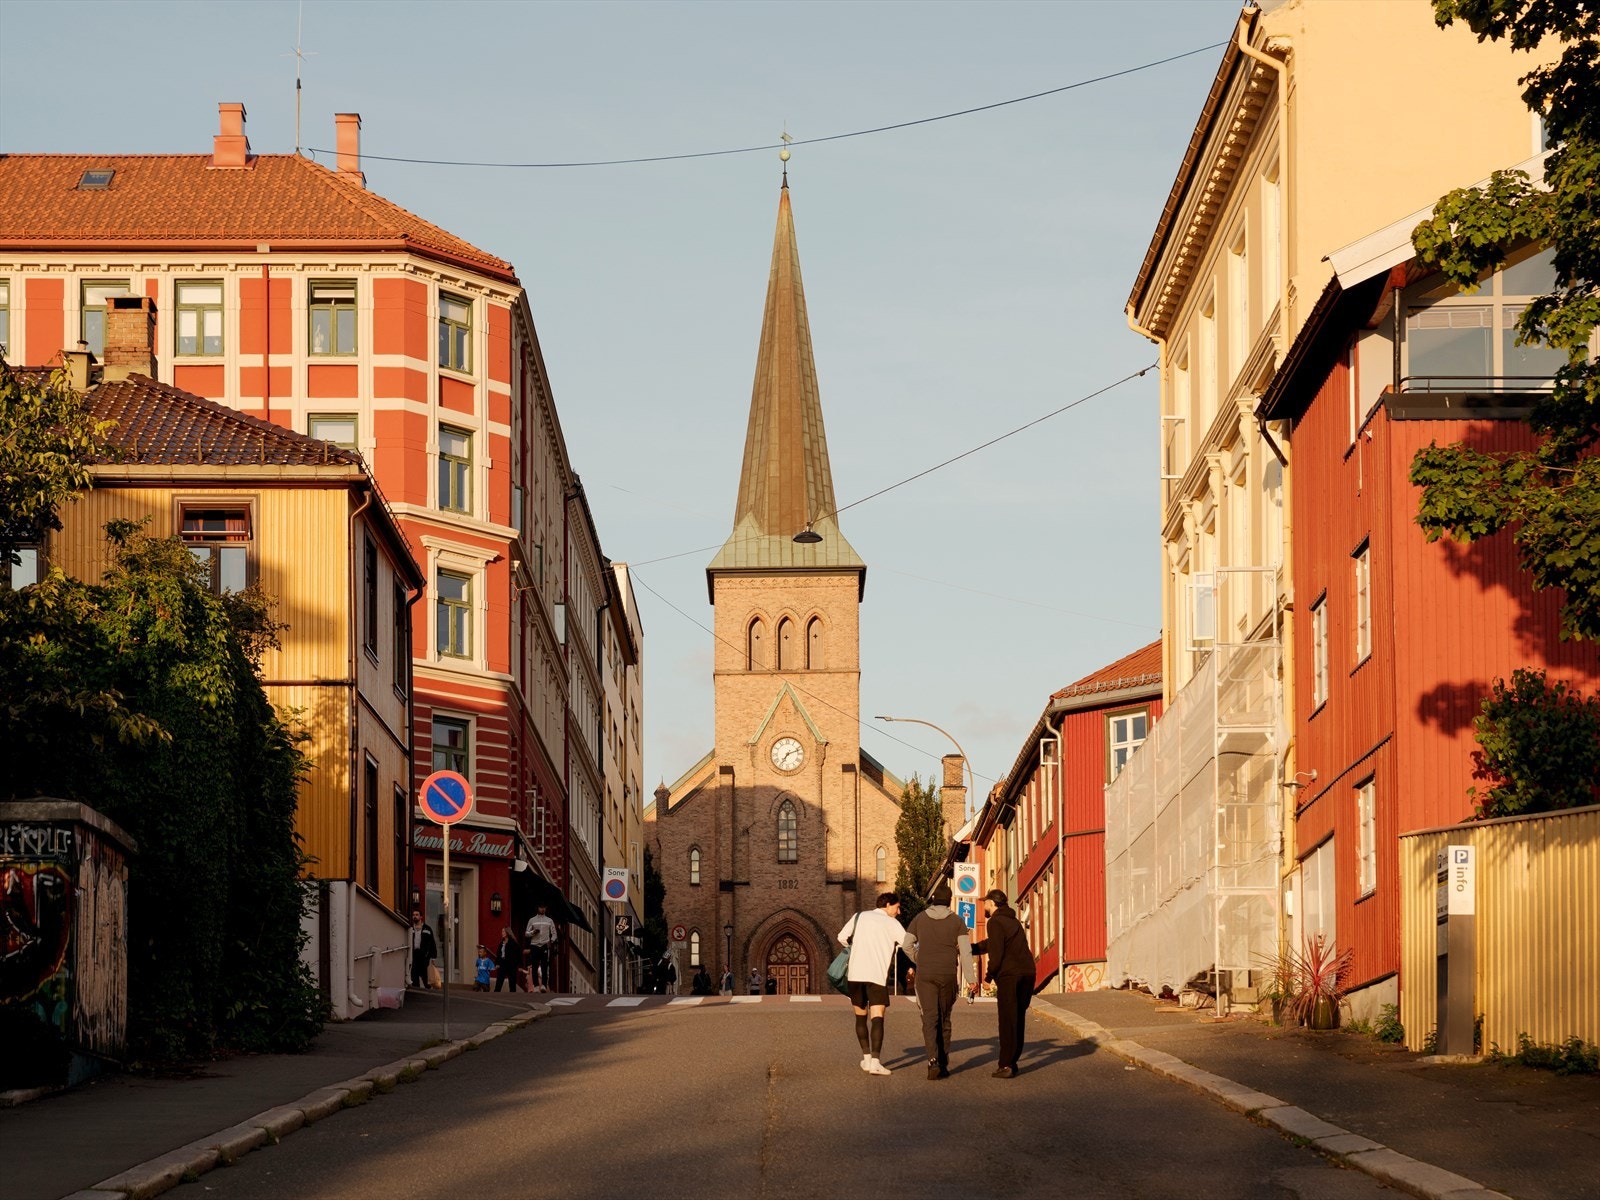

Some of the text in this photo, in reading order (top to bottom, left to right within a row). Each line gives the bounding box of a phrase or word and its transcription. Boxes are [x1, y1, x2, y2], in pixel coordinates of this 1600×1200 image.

[466, 832, 513, 857] Ruud
[1456, 850, 1468, 864] P
[607, 868, 625, 877] Sone
[958, 864, 976, 872] Sone
[777, 879, 799, 890] 1882
[1456, 866, 1468, 892] info
